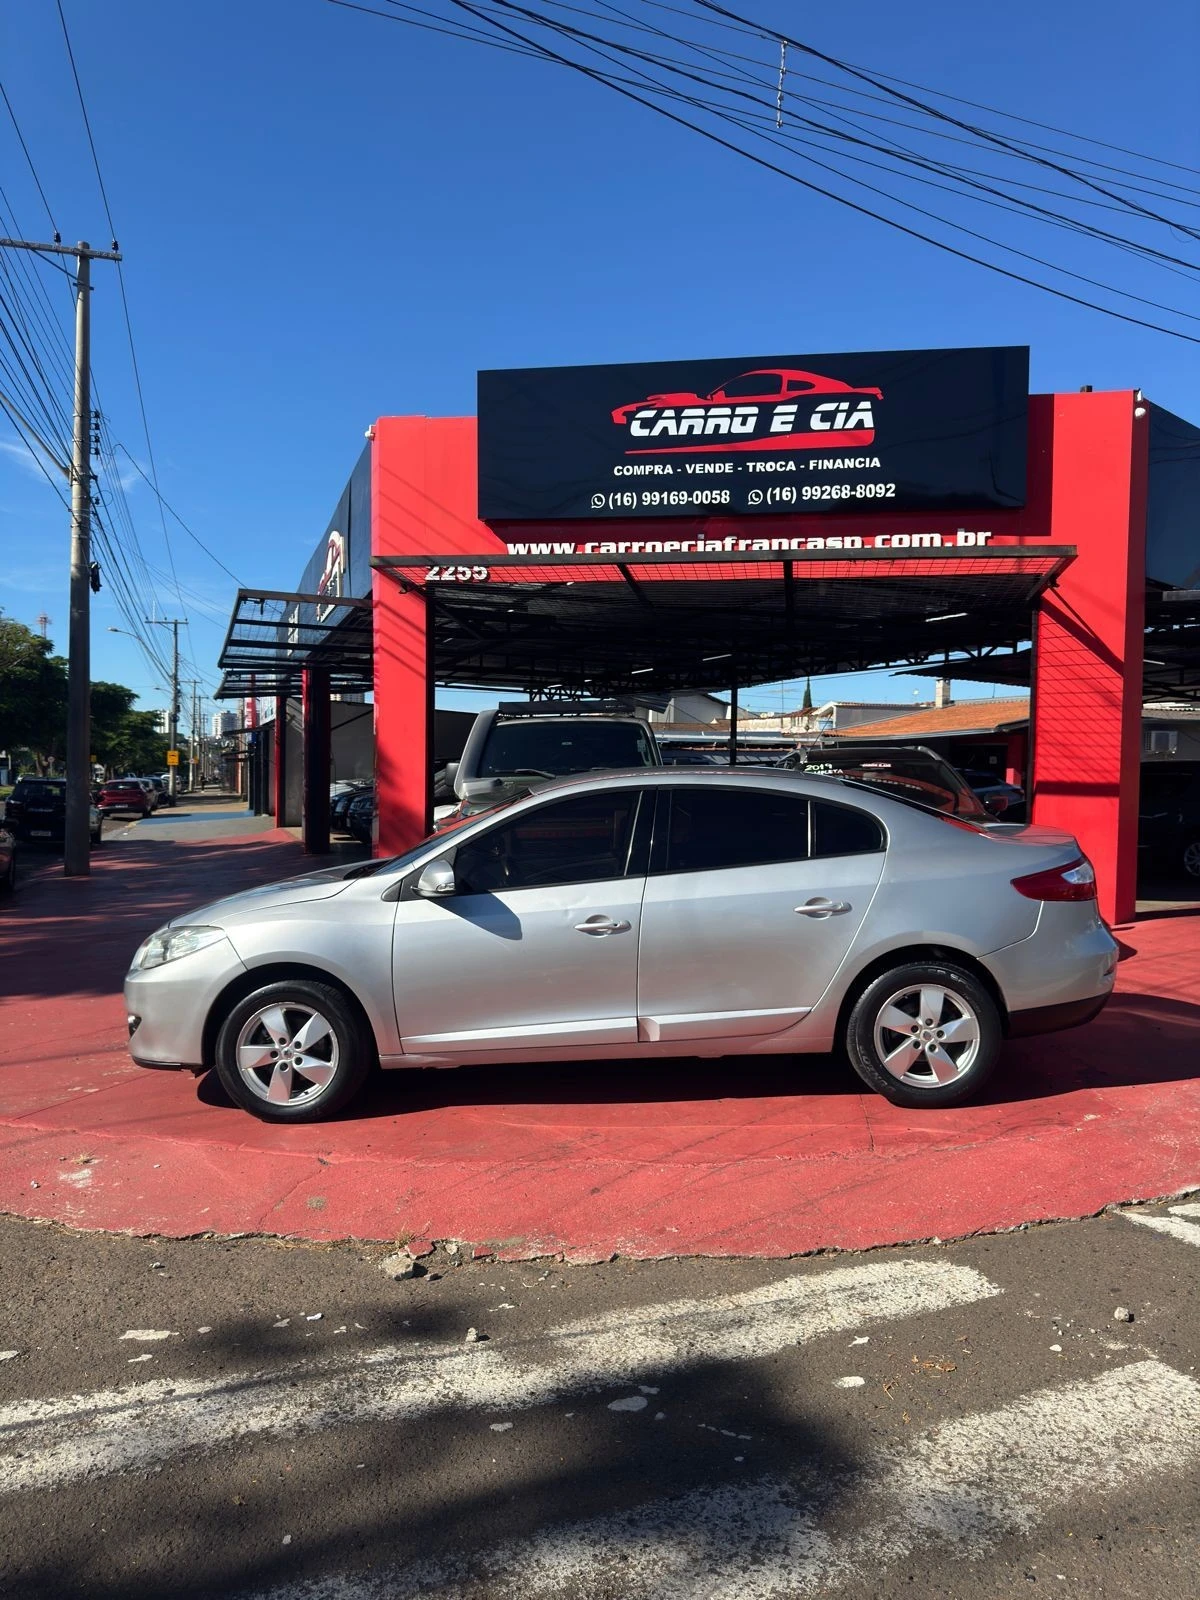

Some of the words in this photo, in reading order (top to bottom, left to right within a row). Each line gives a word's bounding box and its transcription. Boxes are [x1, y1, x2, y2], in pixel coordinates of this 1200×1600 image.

[630, 406, 759, 437] CARRO
[770, 404, 799, 433] E
[810, 401, 875, 430] CIA
[613, 464, 674, 476] COMPRA
[685, 462, 734, 474] VENDE
[746, 461, 796, 473] TROCA
[809, 457, 881, 471] FINANCIA
[608, 492, 637, 510] (16)
[641, 489, 731, 506] 99169-0058
[766, 486, 797, 505] (16)
[801, 483, 896, 500] 99268-8092
